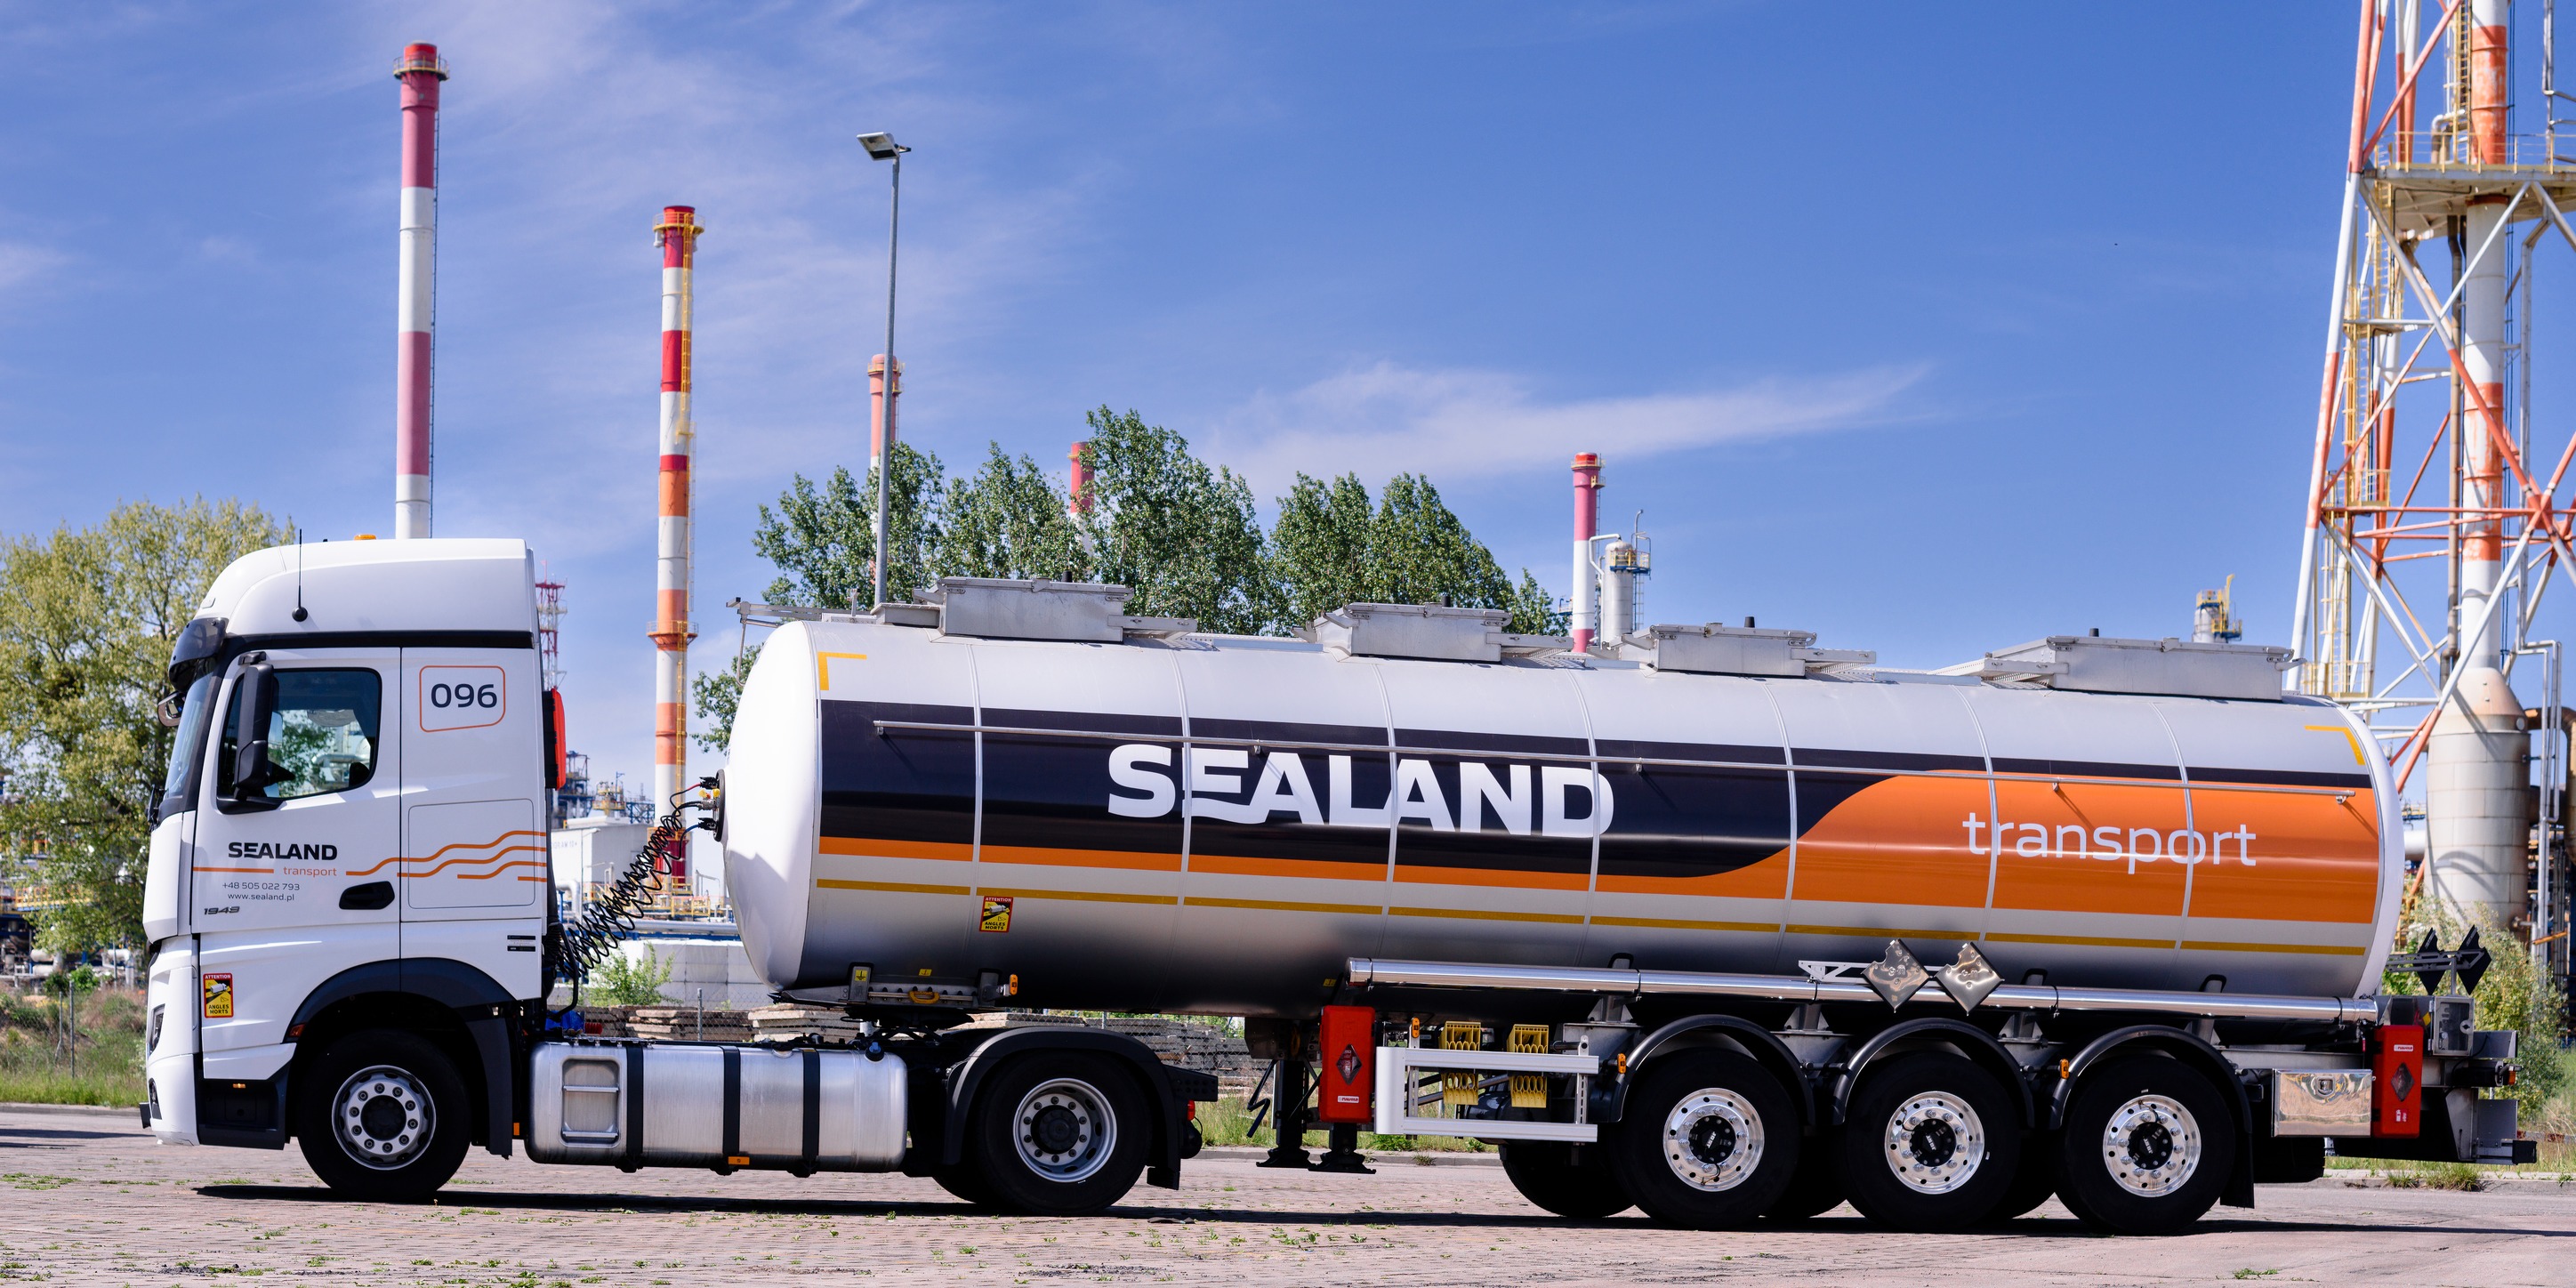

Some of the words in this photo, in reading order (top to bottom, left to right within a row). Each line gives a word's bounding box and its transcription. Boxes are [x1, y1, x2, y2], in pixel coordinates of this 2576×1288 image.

[431, 683, 497, 708] 096
[1107, 744, 1614, 839] SEALAND
[228, 841, 338, 861] SEALAND
[1962, 812, 2257, 875] transport
[283, 866, 337, 878] transport
[222, 881, 240, 890] +48
[242, 881, 260, 890] 505
[262, 882, 279, 890] 022
[282, 882, 301, 891] 793
[228, 893, 294, 902] www.sealand.pl
